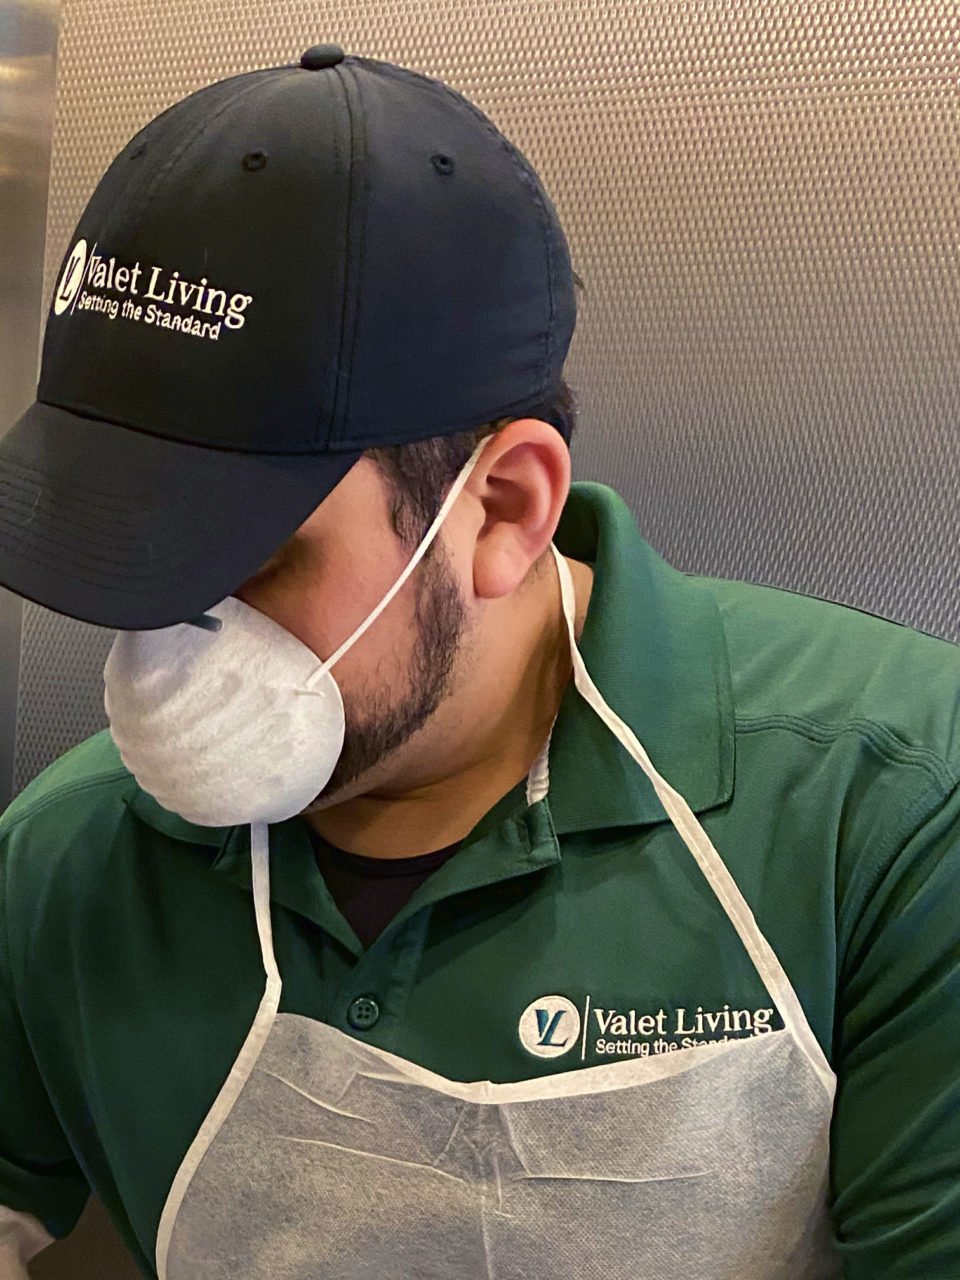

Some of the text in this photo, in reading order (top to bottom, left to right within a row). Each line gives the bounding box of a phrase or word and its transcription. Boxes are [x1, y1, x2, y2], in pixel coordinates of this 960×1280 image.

[87, 255, 253, 329] Valet Living
[77, 290, 222, 341] Setting the Standard
[593, 1004, 775, 1037] Valet Living
[595, 1038, 650, 1057] Setting
[652, 1037, 679, 1054] the
